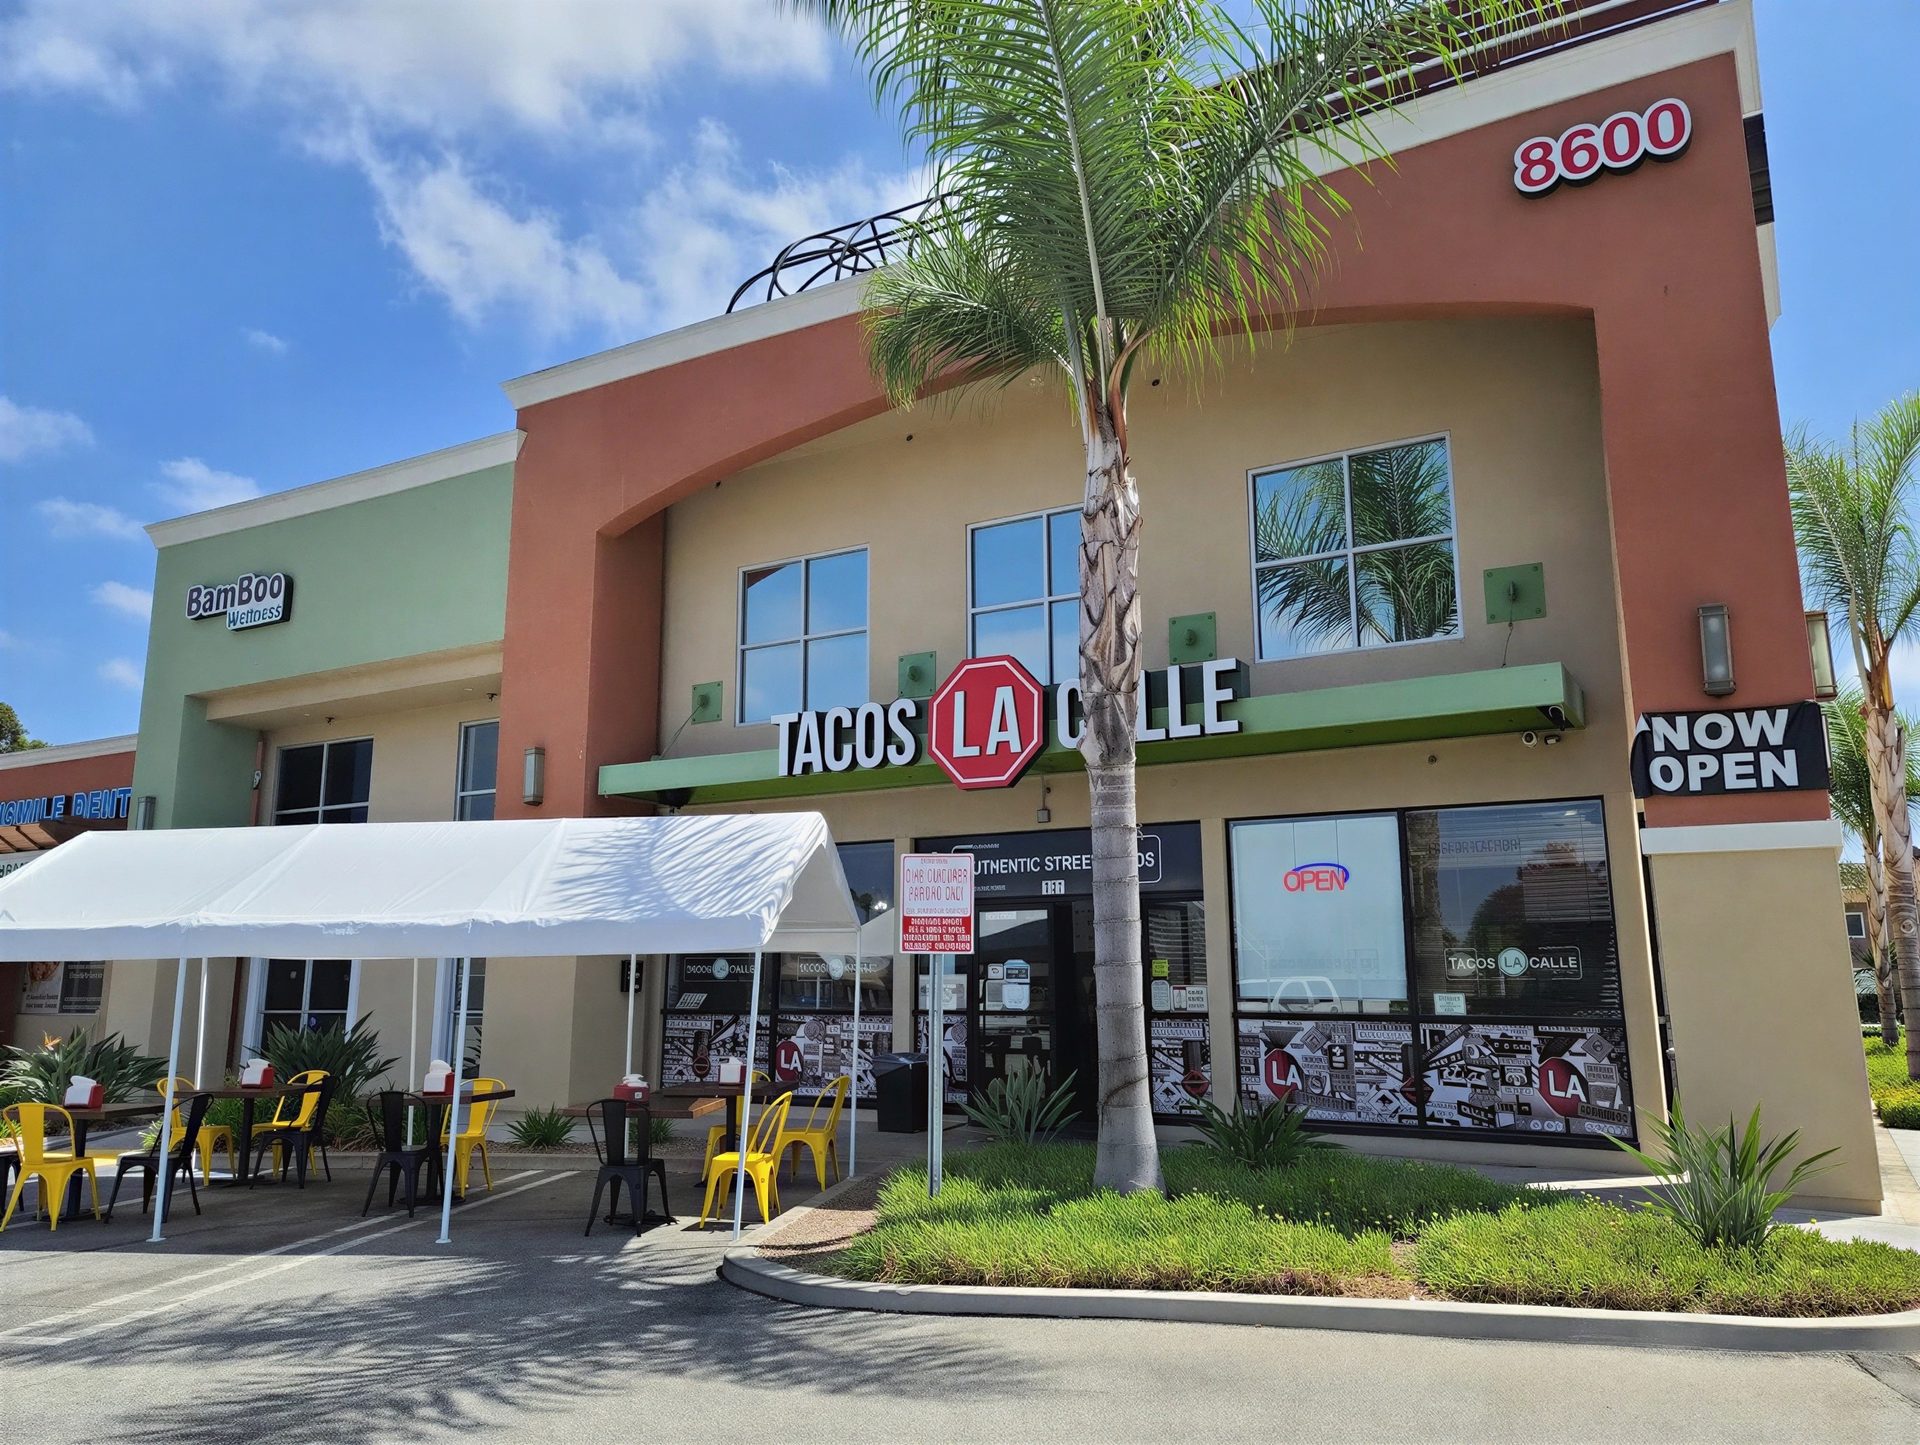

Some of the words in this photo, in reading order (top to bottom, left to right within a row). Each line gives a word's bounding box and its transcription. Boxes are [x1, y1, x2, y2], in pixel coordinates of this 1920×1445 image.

[1518, 101, 1688, 189] 8600
[186, 574, 283, 617] BamBoo
[227, 605, 282, 628] Wellness
[770, 698, 919, 777] TACOS
[952, 685, 1023, 758] LA
[1056, 657, 1241, 750] CLLE
[1651, 708, 1789, 752] NOW
[1649, 748, 1800, 792] OPEN
[973, 856, 1041, 876] UTHENTIC
[1044, 853, 1094, 872] STREE
[1283, 869, 1345, 893] OPEN
[1449, 957, 1496, 970] TACOS
[1504, 956, 1523, 968] LA
[1529, 956, 1578, 969] CALLE
[780, 1049, 803, 1073] LA
[1271, 1060, 1304, 1091] LA
[1547, 1069, 1588, 1103] LA
